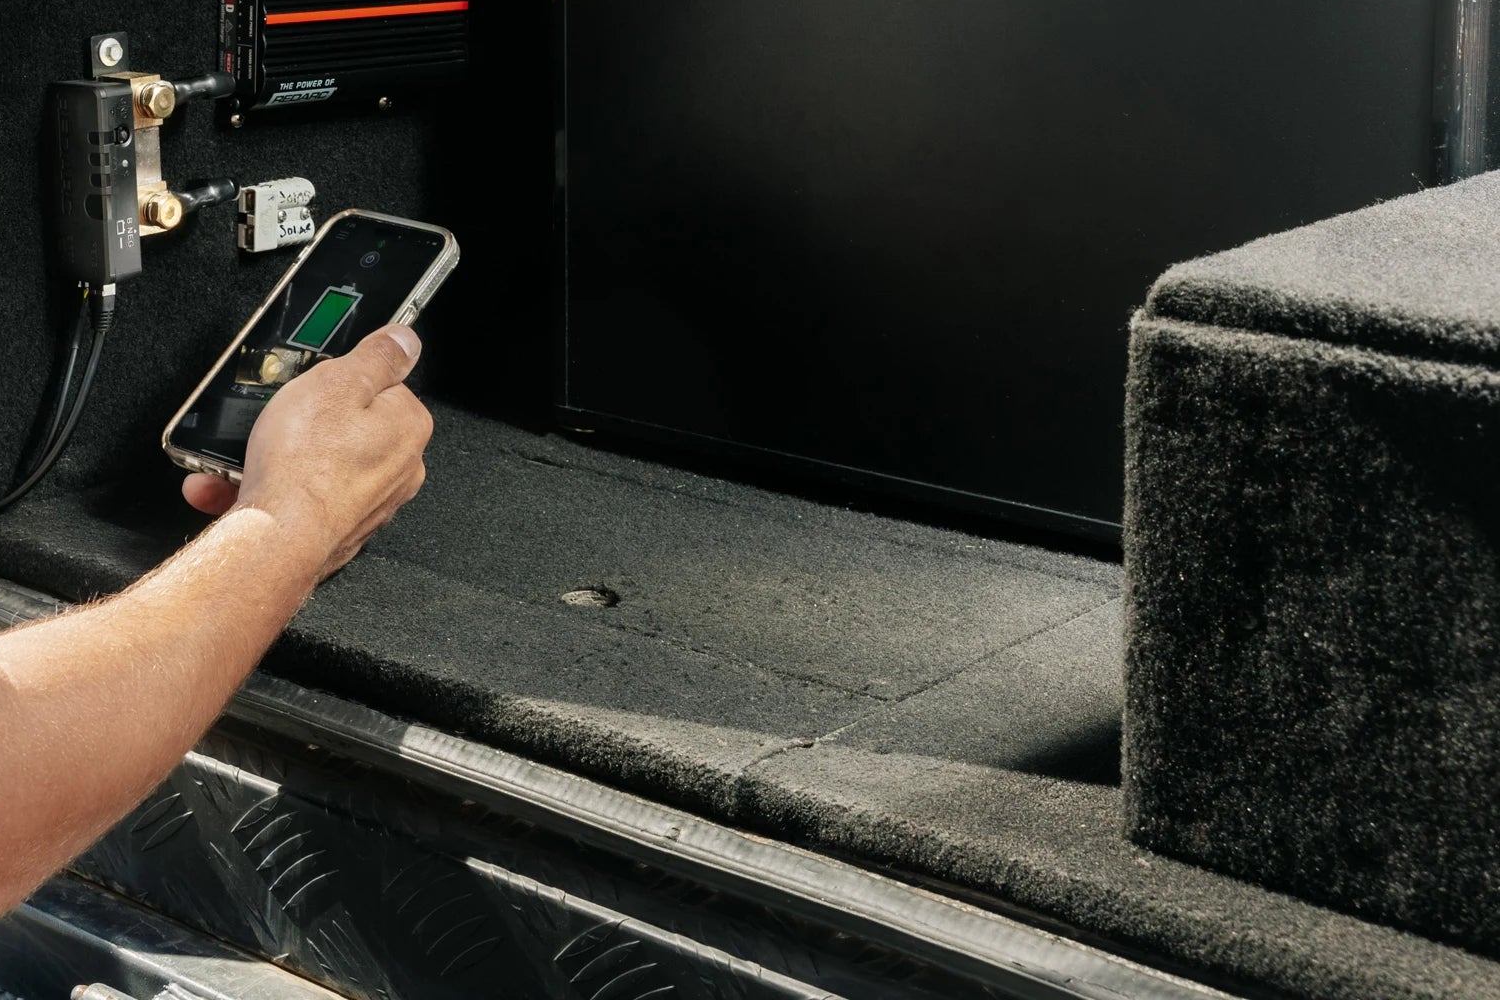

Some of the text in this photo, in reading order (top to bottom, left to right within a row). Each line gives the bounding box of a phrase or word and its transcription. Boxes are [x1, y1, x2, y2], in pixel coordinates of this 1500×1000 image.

[279, 78, 336, 91] THE POWER OF
[271, 91, 330, 103] REDARC
[126, 217, 134, 248] B NEG
